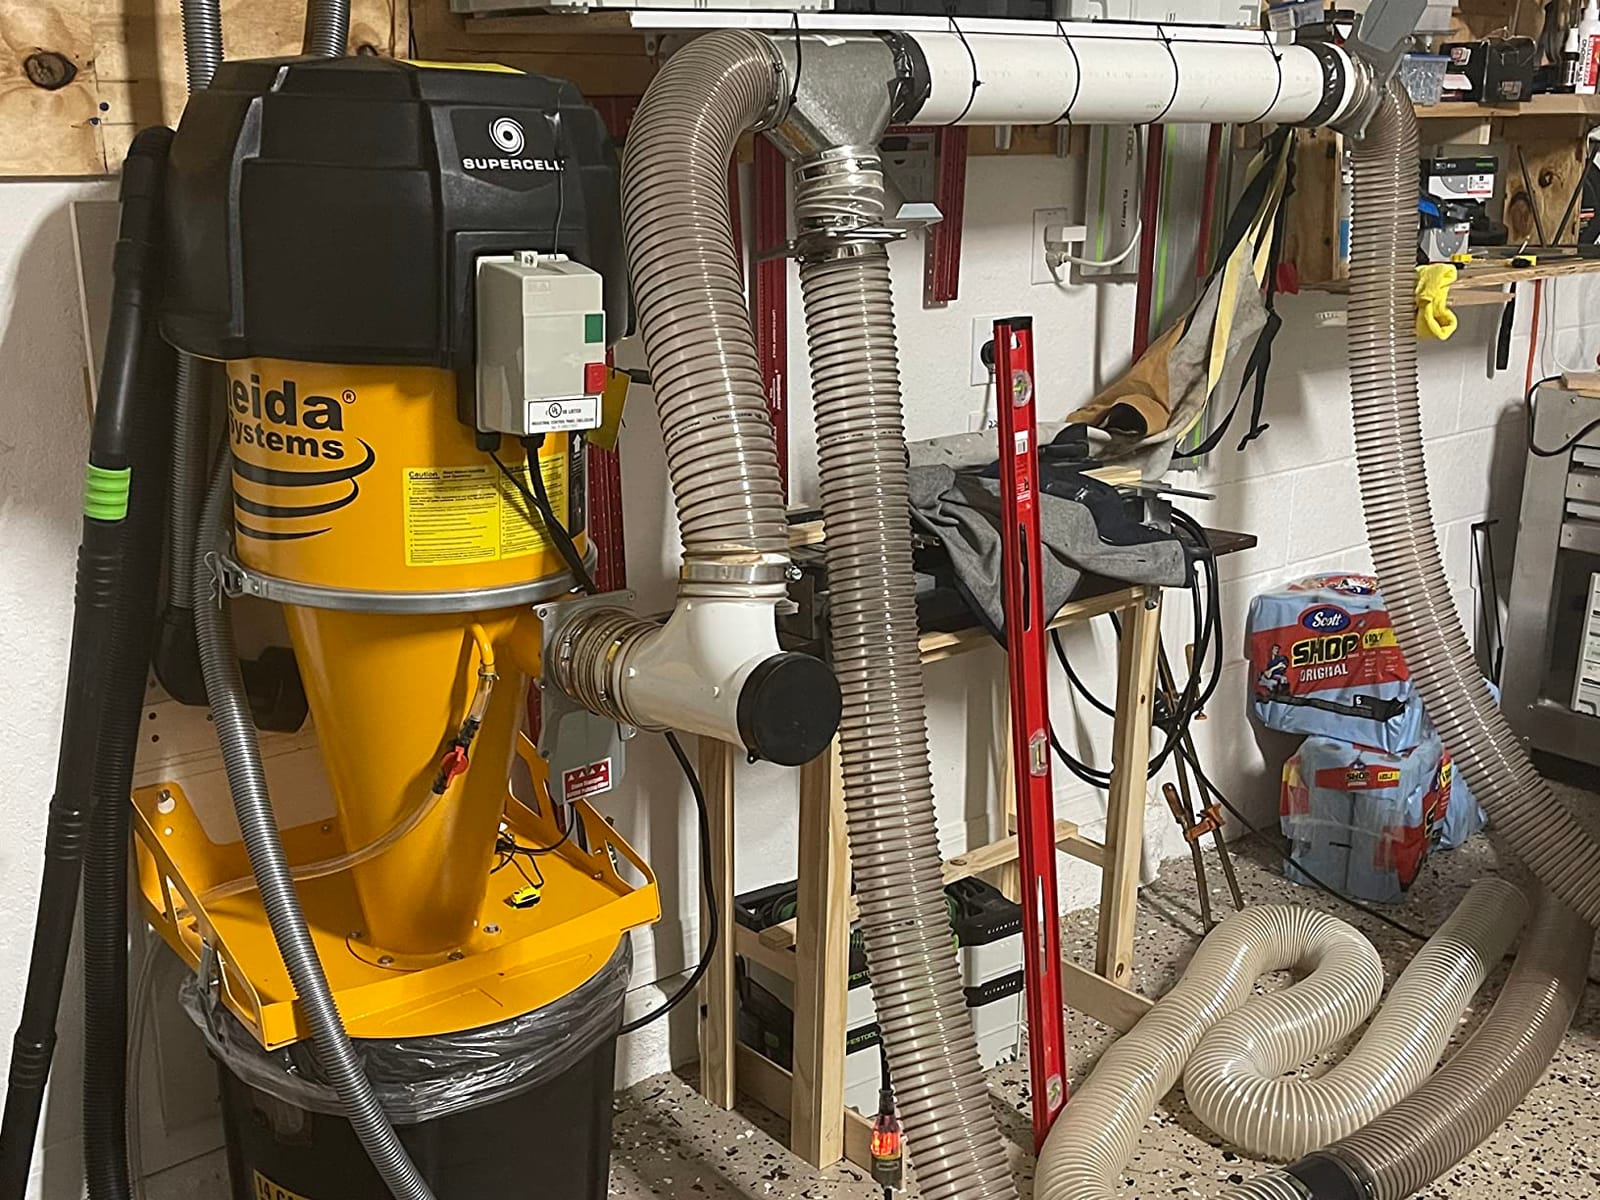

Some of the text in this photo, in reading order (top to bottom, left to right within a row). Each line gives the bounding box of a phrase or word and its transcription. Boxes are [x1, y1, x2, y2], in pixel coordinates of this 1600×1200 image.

[229, 374, 344, 431] eida
[1311, 611, 1342, 628] Scott
[1292, 633, 1360, 667] SHOP
